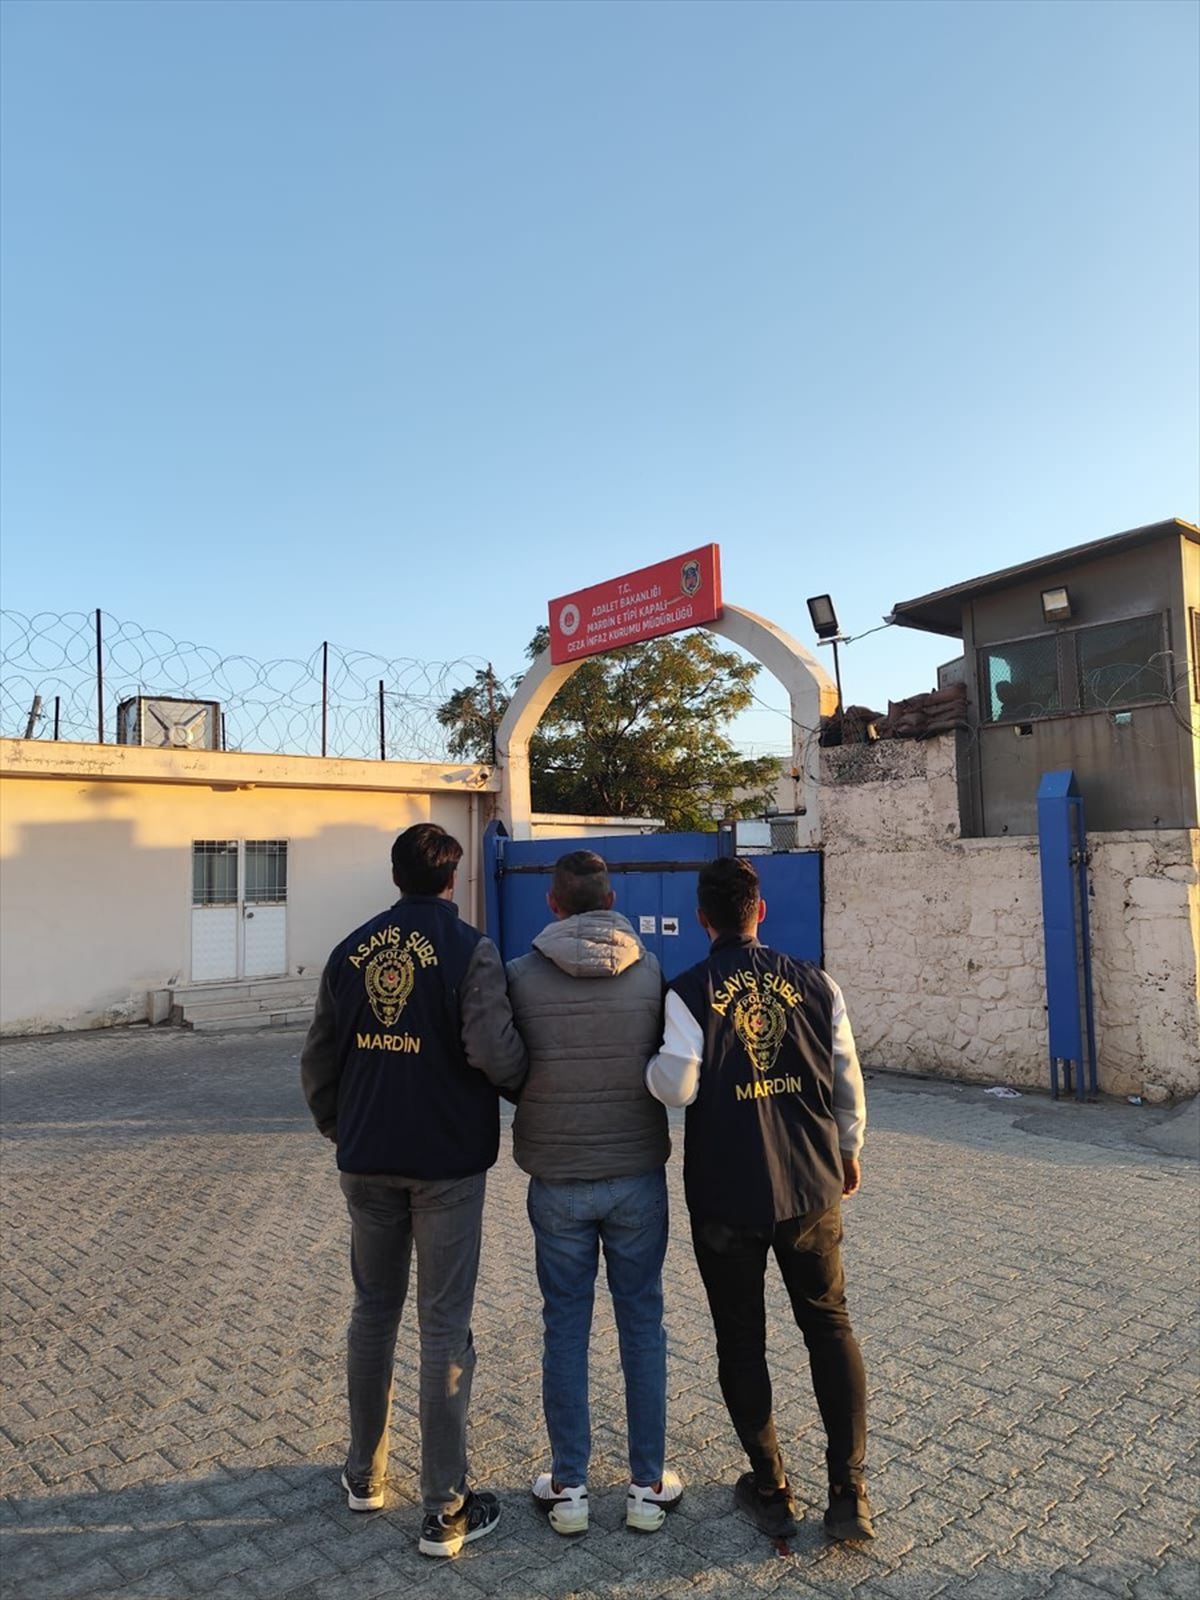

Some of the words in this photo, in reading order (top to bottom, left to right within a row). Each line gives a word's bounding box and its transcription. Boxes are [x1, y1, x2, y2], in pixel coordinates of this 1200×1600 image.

[591, 602, 619, 617] ADALET
[619, 584, 662, 607] BAKANLIĞI
[618, 583, 631, 594] T.C.
[567, 637, 585, 652] CEZA
[586, 632, 608, 648] İNFAZ
[608, 622, 641, 640] KURUMU
[642, 604, 693, 631] MÜDÜRLÜĞÜ
[586, 615, 616, 633] MARDİN
[617, 613, 622, 623] E
[623, 608, 638, 623] TİPİ
[349, 925, 401, 968] ASAYİŞ
[404, 931, 438, 968] ŞUBE
[712, 969, 758, 1016] ASAYİŞ
[763, 972, 803, 1008] ŞUBE
[357, 1032, 421, 1053] MARDİN
[736, 1074, 801, 1100] MARDİN
